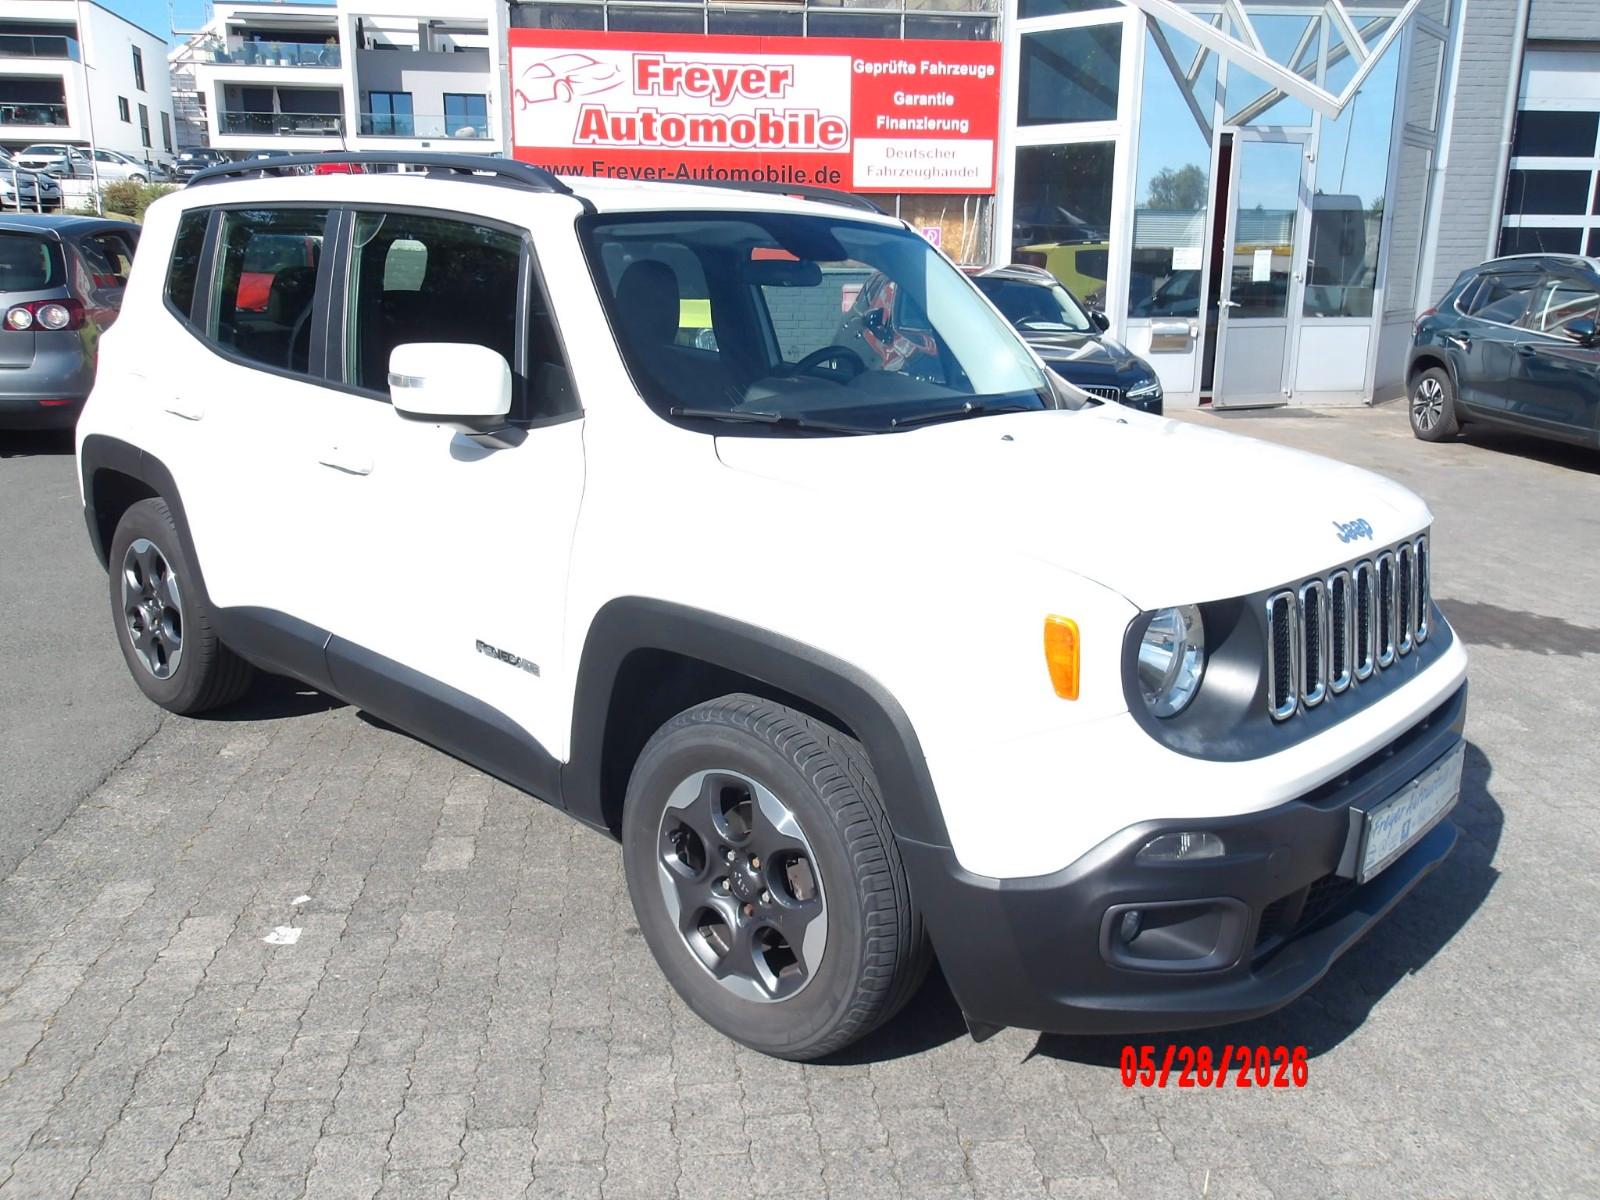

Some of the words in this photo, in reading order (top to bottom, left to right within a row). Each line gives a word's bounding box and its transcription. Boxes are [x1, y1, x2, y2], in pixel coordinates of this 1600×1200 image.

[853, 59, 916, 76] Geprüfte
[920, 60, 995, 79] Fahrzeuge
[633, 54, 793, 106] Freyer
[893, 91, 955, 106] Garantie
[574, 104, 848, 149] Automobile
[876, 115, 969, 133] Finanzierung
[885, 147, 957, 160] Deutscher
[867, 165, 979, 180] Fahrzeughandel
[1332, 518, 1373, 543] Jeep
